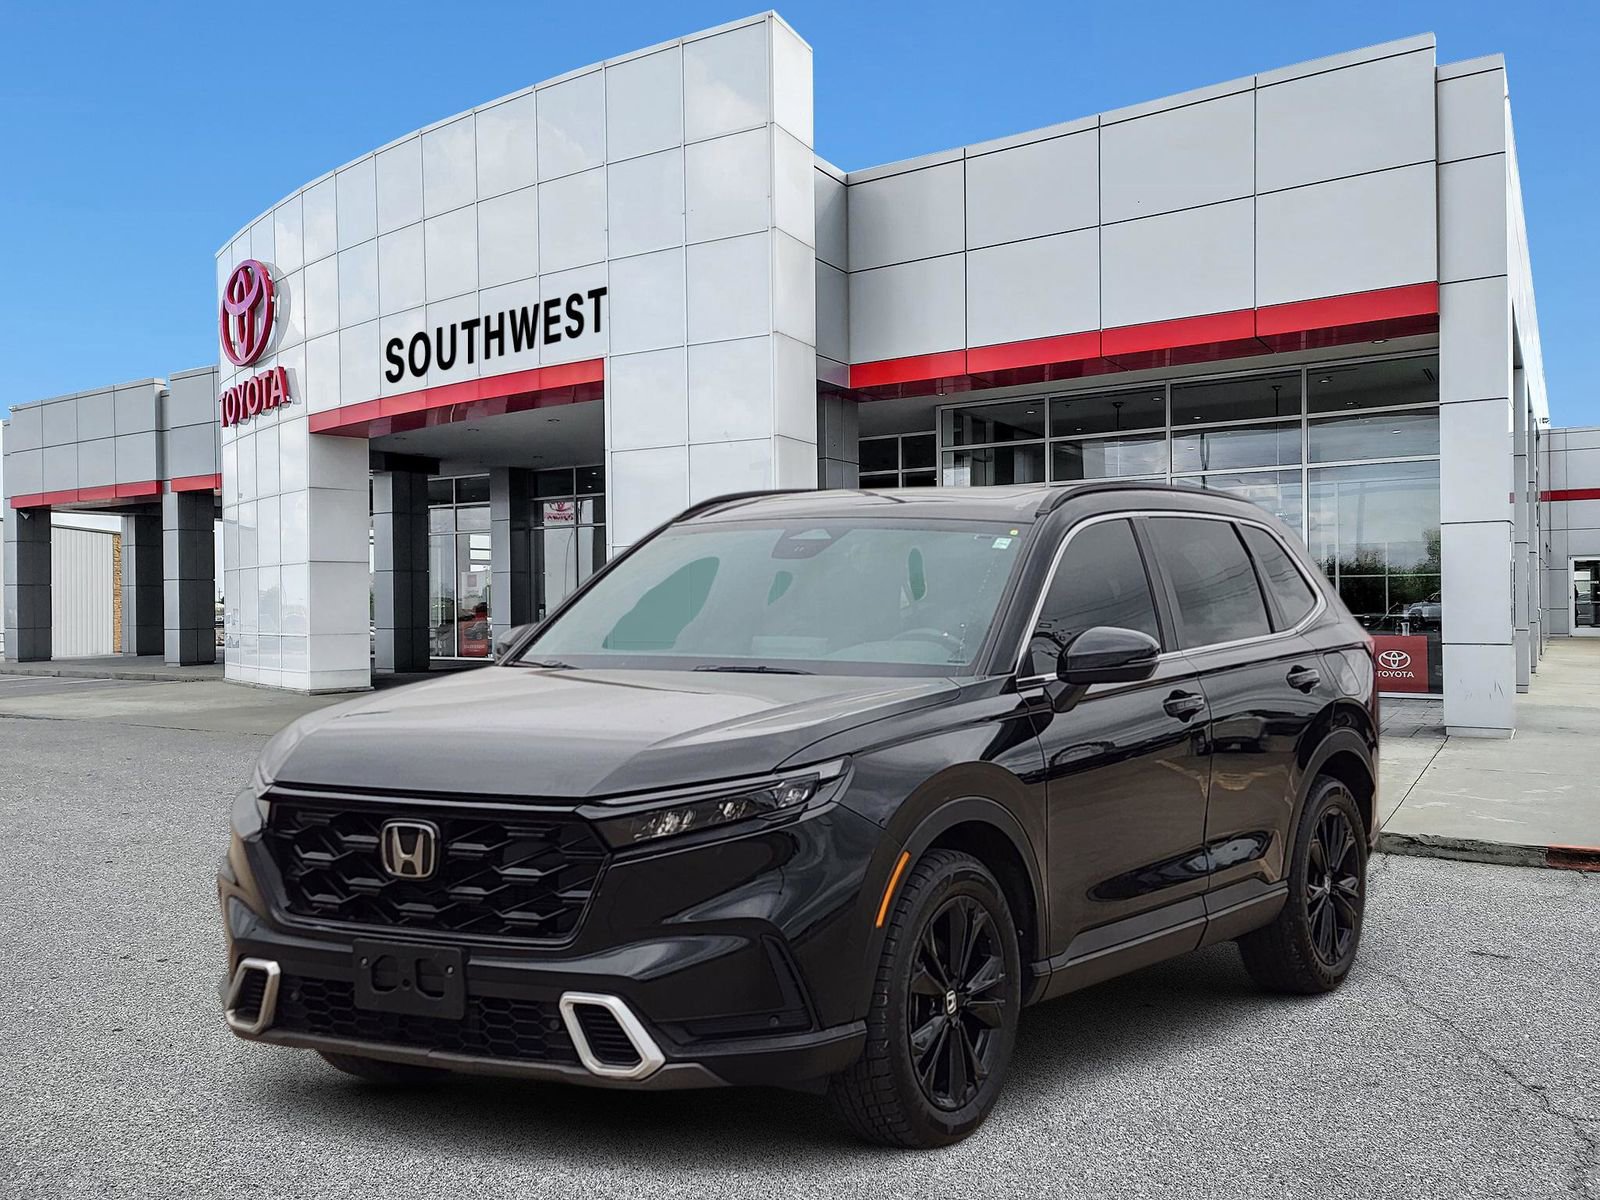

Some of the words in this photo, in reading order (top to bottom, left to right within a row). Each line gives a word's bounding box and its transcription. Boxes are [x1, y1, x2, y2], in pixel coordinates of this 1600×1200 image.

[385, 286, 608, 383] SOUTHWEST
[219, 366, 291, 428] TOYOTA
[1377, 670, 1415, 678] TOYOTA
